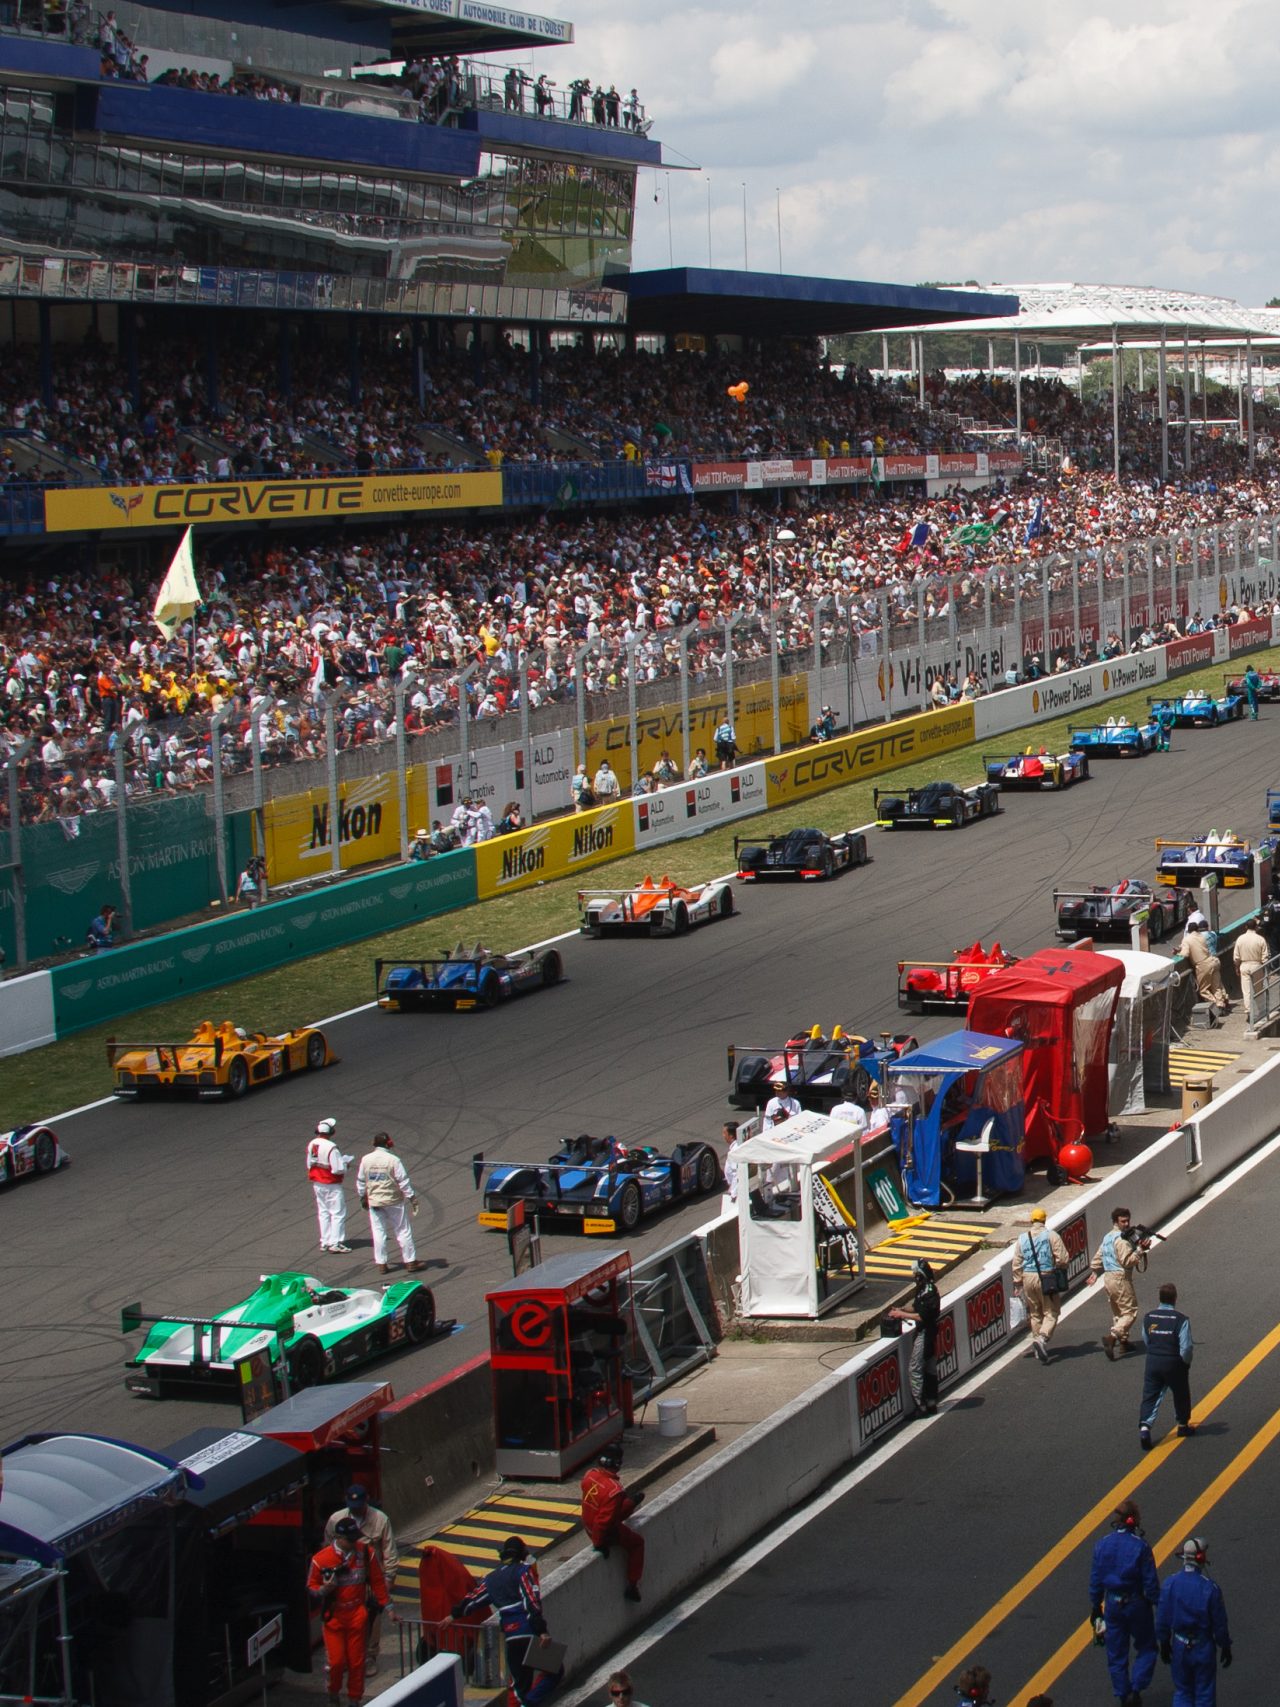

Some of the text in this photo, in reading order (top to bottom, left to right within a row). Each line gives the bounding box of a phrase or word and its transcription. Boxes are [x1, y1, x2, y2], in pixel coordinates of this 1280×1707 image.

[463, 5, 564, 37] AUTOMOBILE CLUB DE L'OUEST
[695, 473, 711, 485] Audi
[711, 472, 722, 484] TDI
[722, 472, 743, 483] Power
[828, 466, 868, 478] Audi TDI Power
[153, 481, 461, 519] CORVETTE corvette-europe.com
[1230, 629, 1269, 651] Audi TDI Power
[1168, 647, 1211, 669] Audi TDI Power
[1111, 659, 1157, 689] V-Power Diesel
[1041, 677, 1093, 709] V-Power Diesel
[533, 747, 555, 766] ALD
[793, 716, 973, 787] CORVETTE corvette-europe.com
[456, 762, 479, 783] AD
[534, 765, 570, 785] Automotive
[740, 772, 754, 788] ALD
[650, 800, 664, 813] ALD
[698, 786, 711, 800] ALD
[698, 800, 722, 814] Automotive
[742, 785, 764, 800] Automotive
[651, 814, 675, 828] Automotive
[574, 824, 613, 857] Nikon
[107, 857, 145, 881] ASON
[149, 845, 189, 869] MARTIN
[503, 844, 545, 879] Nikon
[214, 923, 286, 954] ASTON MARTIN RACING
[96, 956, 176, 990] ASTON MARTIN RACING
[1067, 1250, 1089, 1279] urnal
[966, 1279, 1006, 1336] MOTO
[937, 1348, 958, 1382] rnal
[856, 1354, 901, 1417] MOTO
